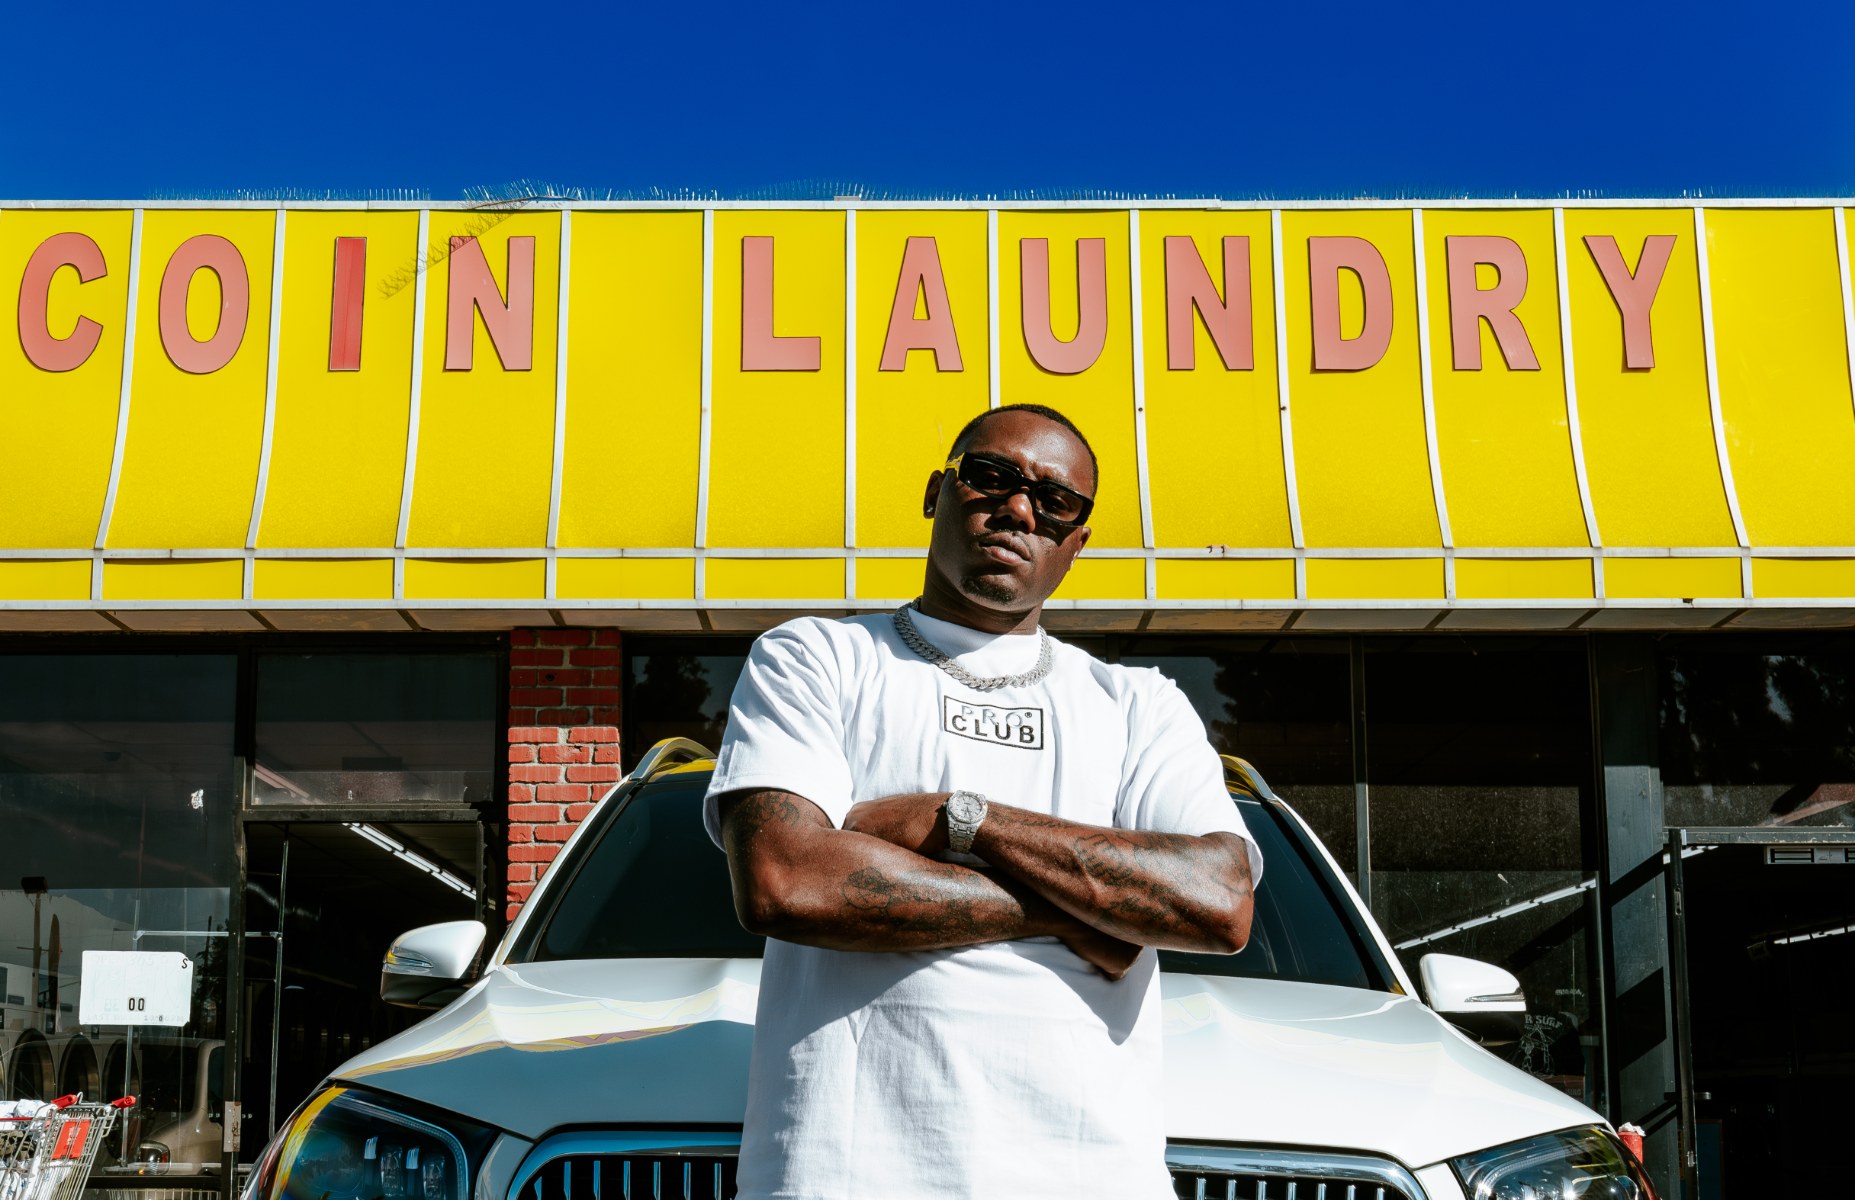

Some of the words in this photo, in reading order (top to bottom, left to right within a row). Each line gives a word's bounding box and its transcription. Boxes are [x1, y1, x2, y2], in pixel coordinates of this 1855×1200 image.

[17, 232, 536, 374] COIN
[741, 234, 1678, 374] LAUNDRY
[952, 715, 1035, 744] CLUB
